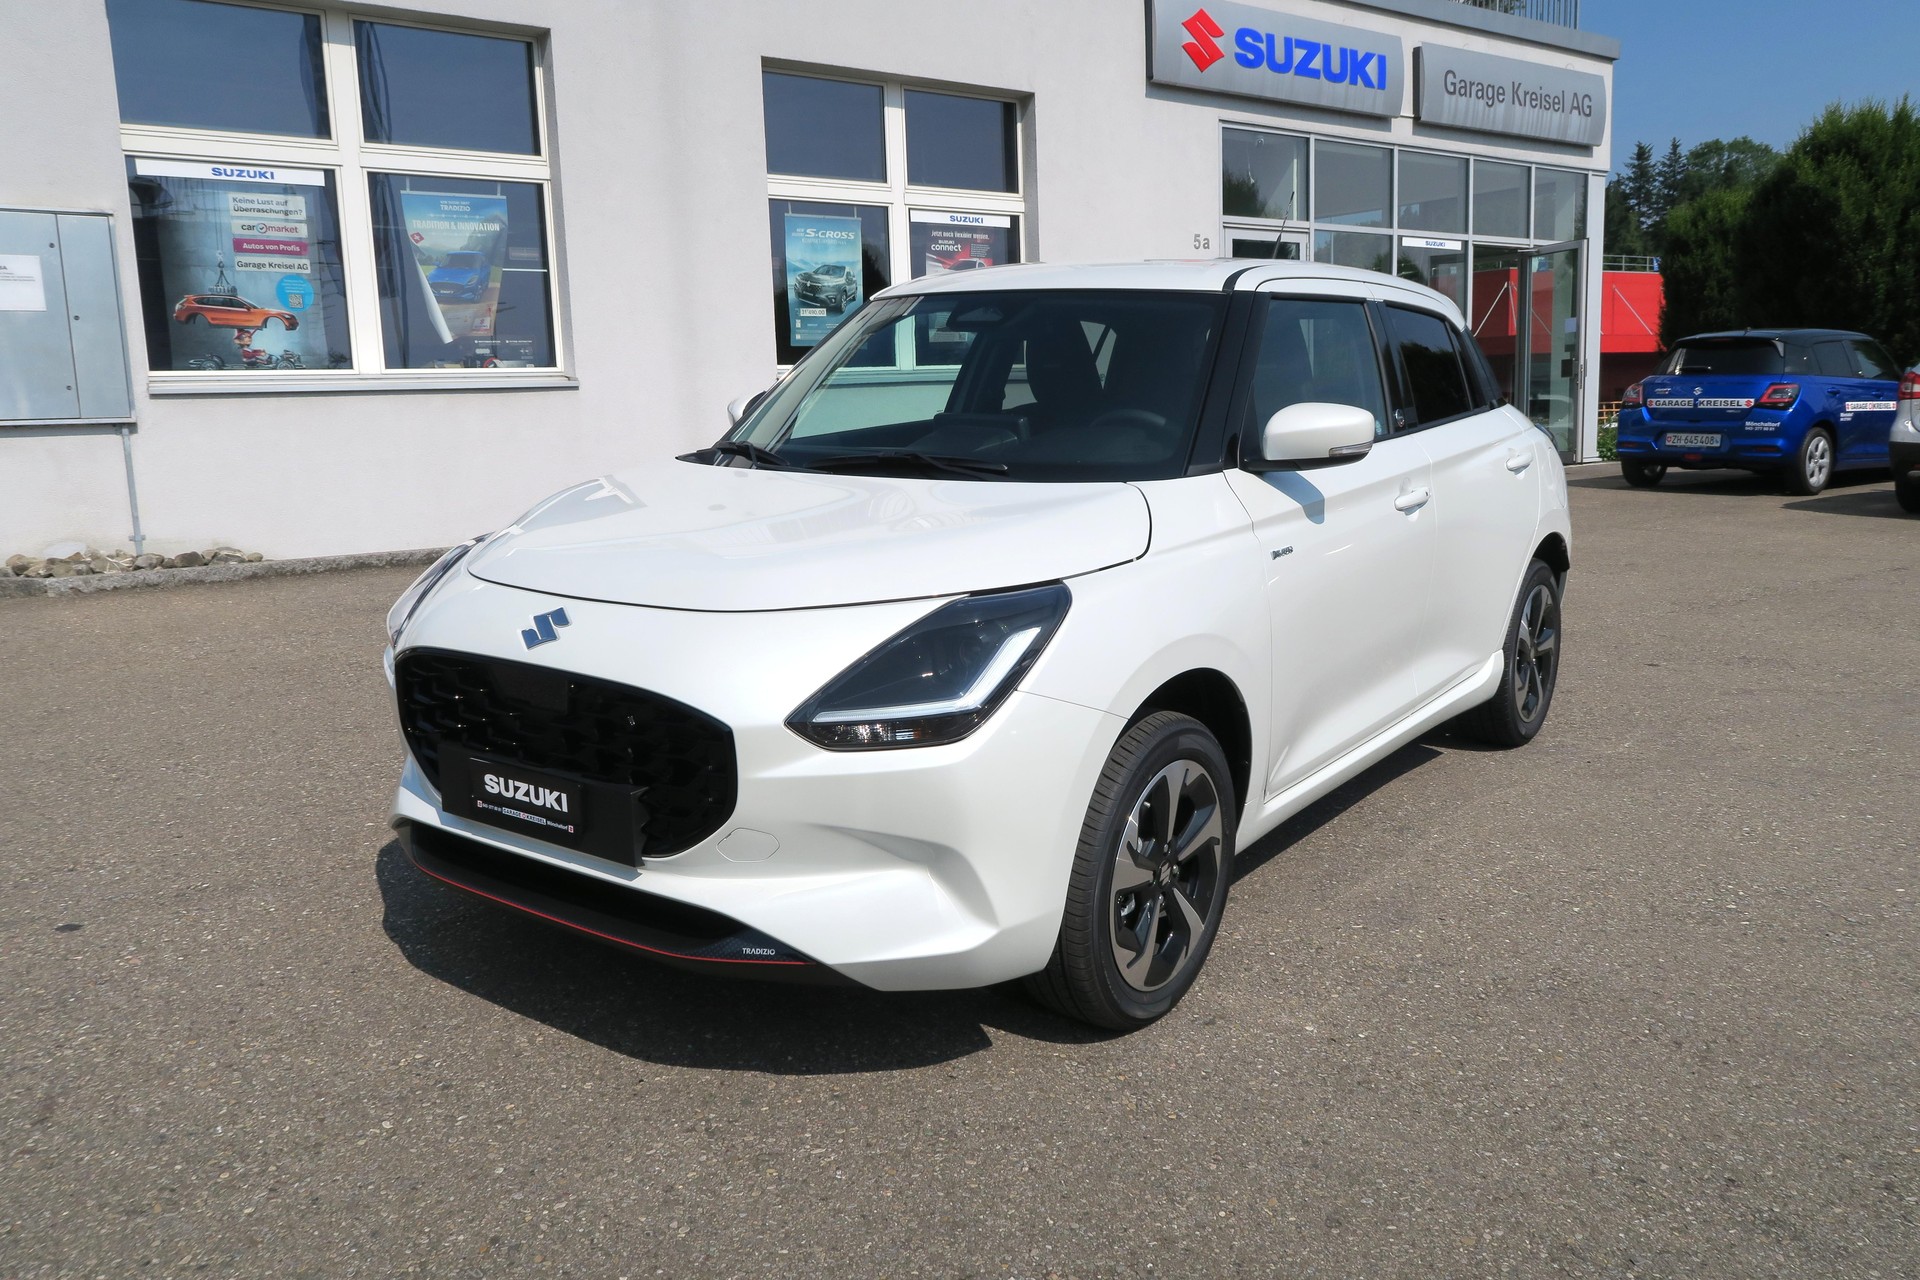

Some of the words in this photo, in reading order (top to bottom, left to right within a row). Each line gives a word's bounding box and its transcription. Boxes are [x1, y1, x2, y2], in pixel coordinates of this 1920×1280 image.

[1234, 28, 1386, 90] SUZUKI
[1443, 69, 1505, 108] Garage
[1511, 81, 1566, 112] Kreisel
[1571, 92, 1592, 118] AG
[211, 167, 275, 180] SUZUKI
[232, 196, 255, 205] Keine
[257, 198, 274, 206] Lust
[275, 199, 289, 207] auf
[233, 204, 303, 216] Überraschungen?
[440, 204, 471, 212] TRADIZIO
[949, 215, 984, 224] SUZUKI
[241, 223, 256, 231] car
[268, 225, 299, 234] market
[412, 219, 451, 230] TRADITION
[450, 221, 457, 230] &
[457, 221, 500, 232] INNOVATION
[243, 242, 265, 250] Autos
[280, 244, 301, 252] Profis
[1193, 233, 1210, 250] 5a
[1425, 240, 1446, 248] SUZUKI
[931, 243, 962, 252] connect
[236, 260, 267, 270] Garage
[268, 261, 295, 270] Kreisel
[296, 263, 309, 271] AG
[1655, 399, 1694, 407] GARAGE
[1698, 399, 1743, 407] KREISEL
[484, 773, 569, 813] SUZUKI
[503, 807, 522, 818] GARAGE
[526, 813, 546, 825] KREISEL
[742, 947, 776, 956] TRADIZIO
